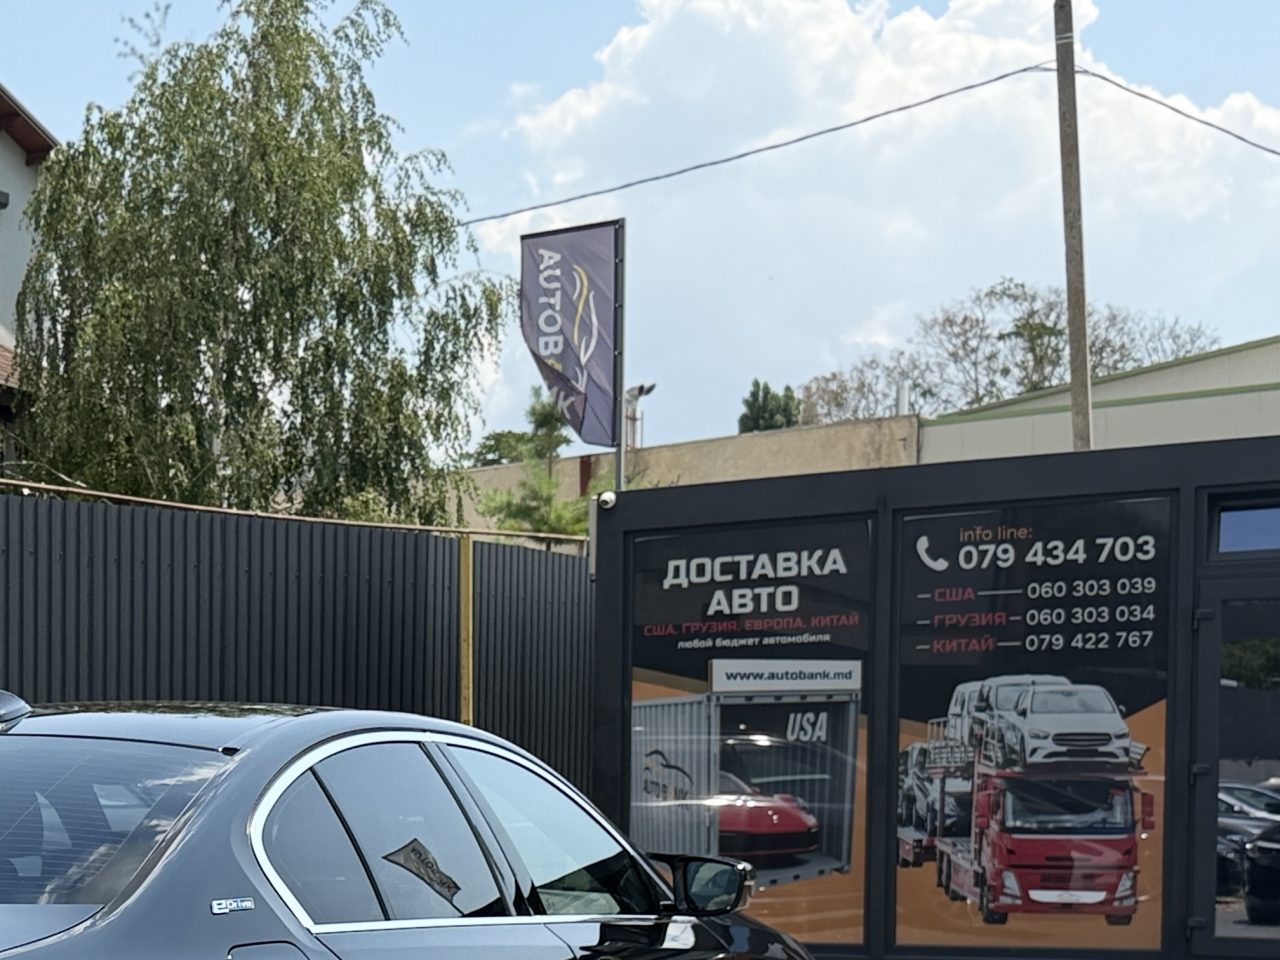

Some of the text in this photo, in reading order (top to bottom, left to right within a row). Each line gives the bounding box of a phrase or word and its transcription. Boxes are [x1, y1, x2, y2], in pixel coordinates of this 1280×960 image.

[960, 525, 1033, 543] info line:
[958, 535, 1156, 570] 079 434 703
[663, 549, 847, 590] ДОСТАВКА
[706, 585, 799, 616] АВТО
[934, 577, 1156, 602] США 060 303 039
[811, 611, 860, 627] КИТАЙ
[934, 604, 1155, 628] ГРУЗИЯ 060 303 034
[678, 633, 831, 649] любой бюджет автомобиля
[933, 630, 1154, 653] КИТАЙ 079 422 767
[725, 669, 853, 681] www.autobank.md
[786, 712, 829, 742] USA
